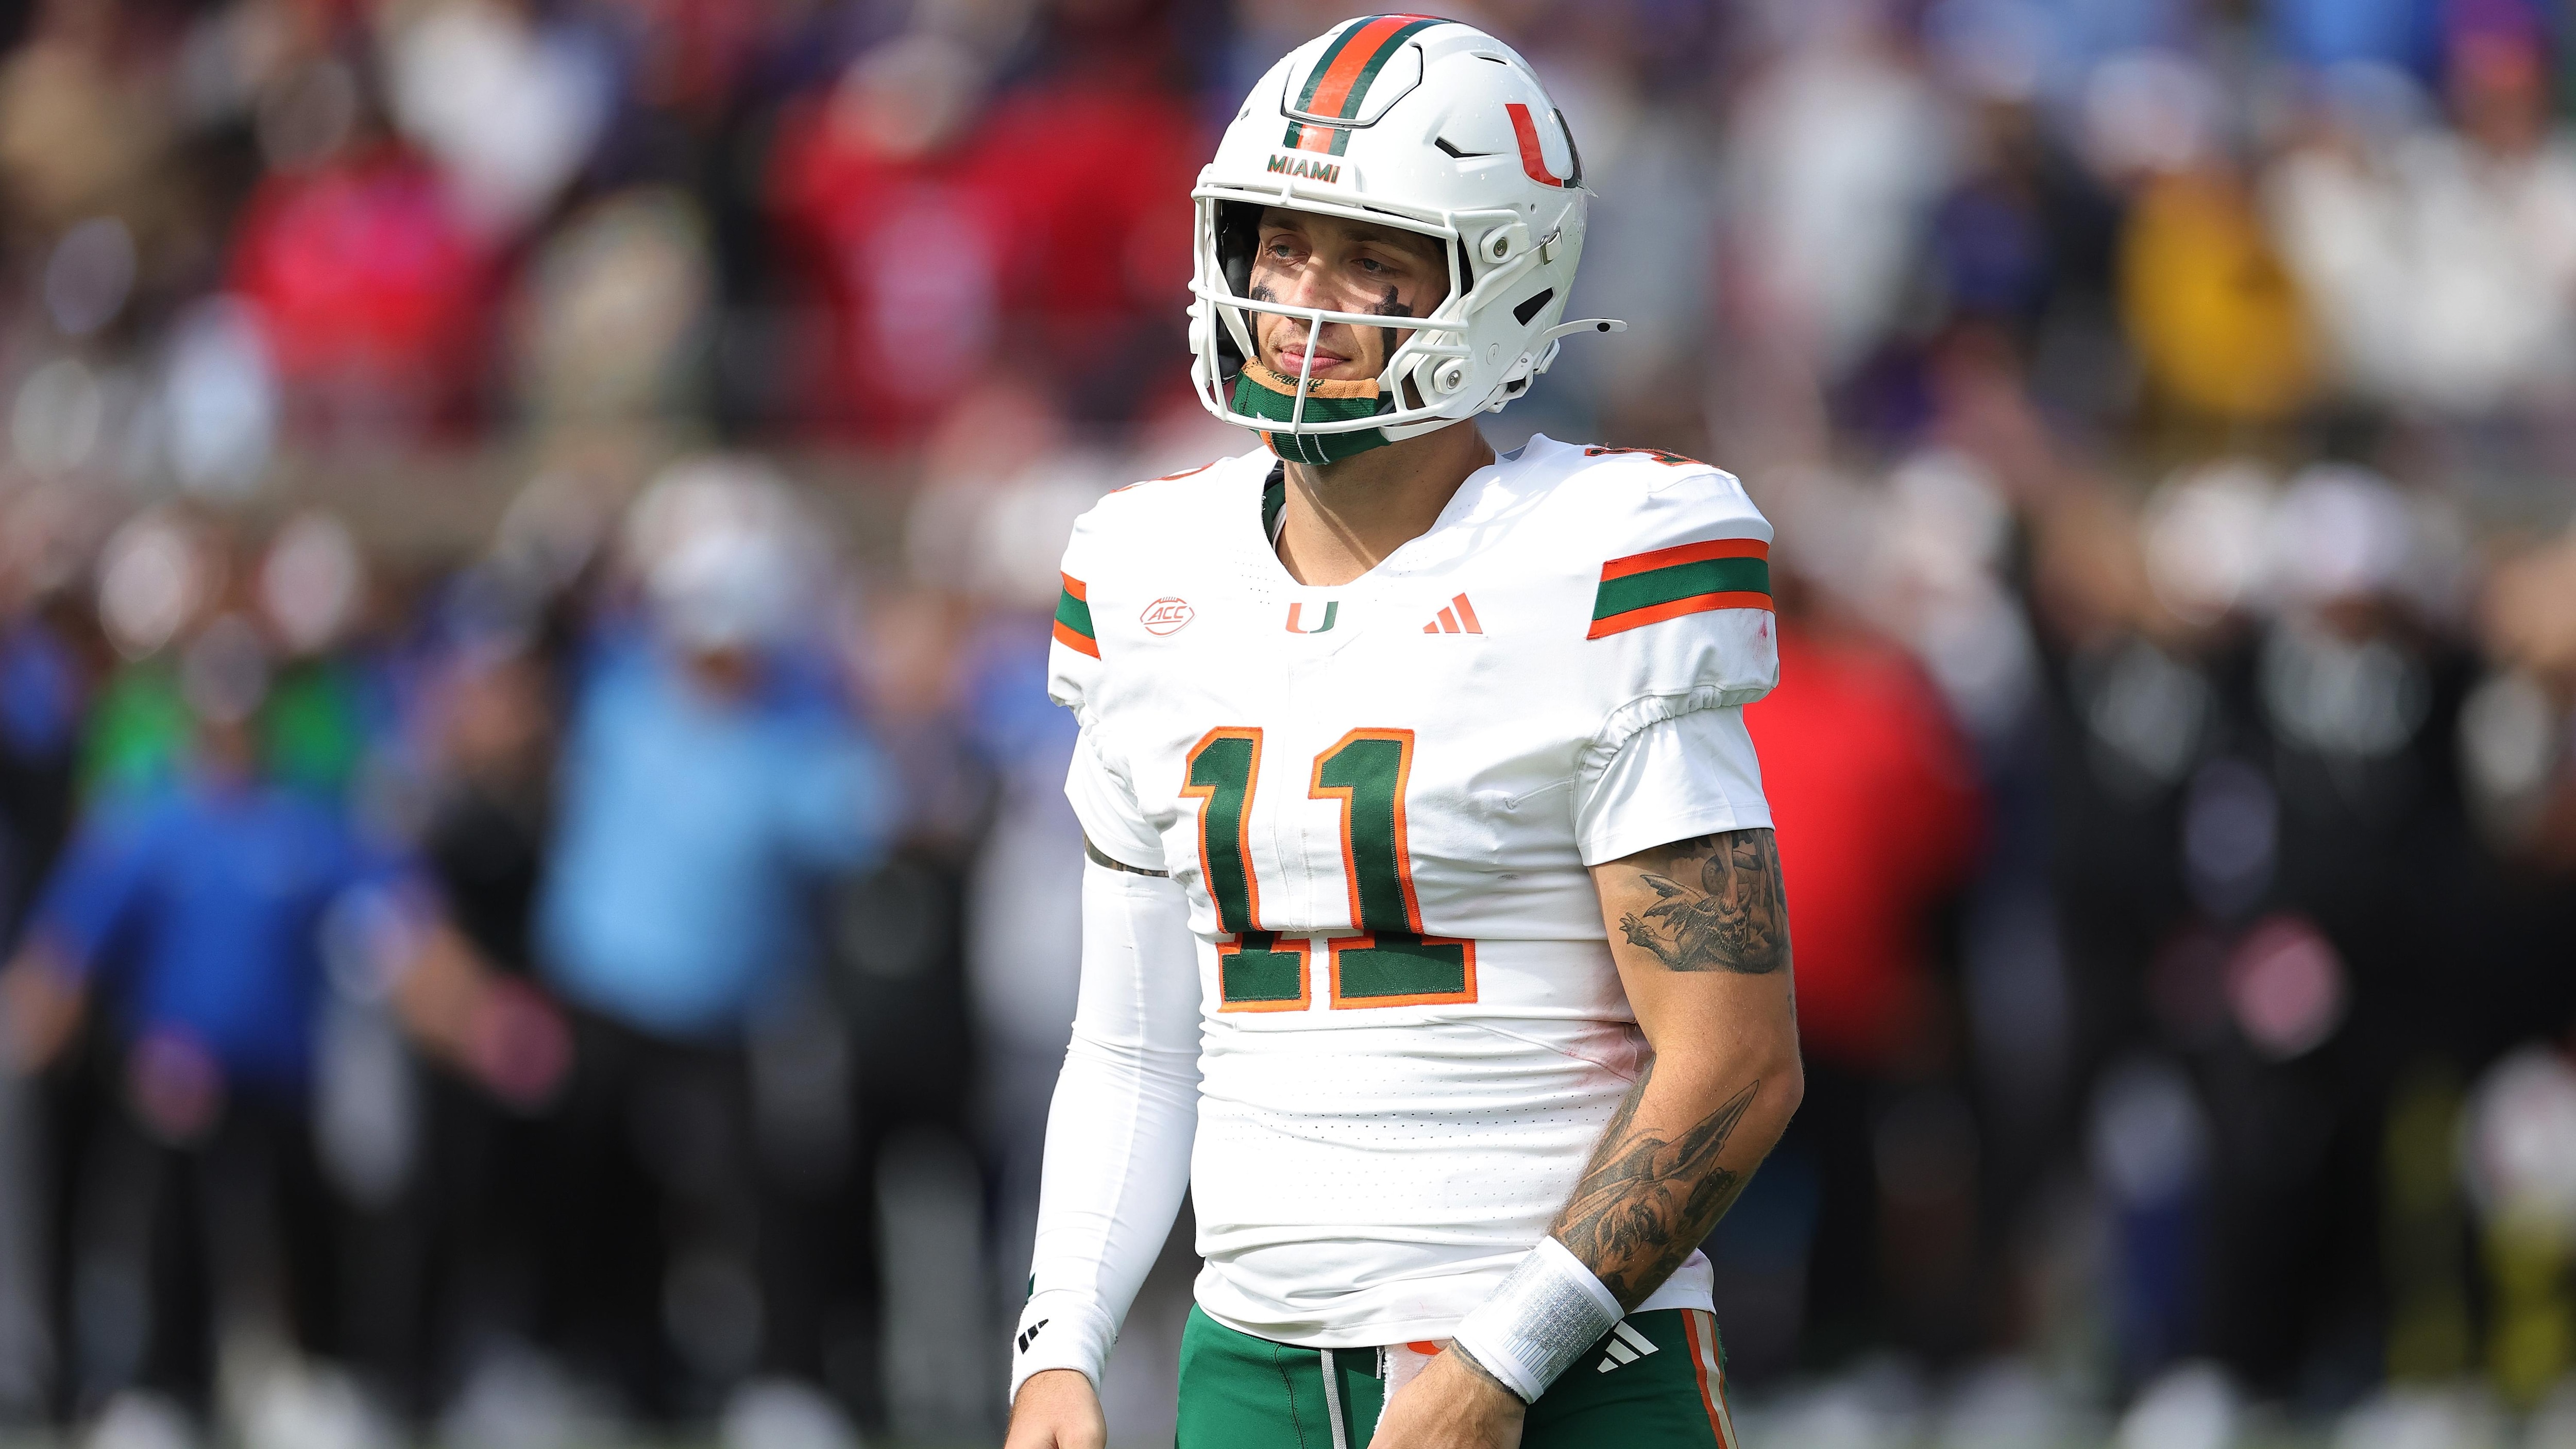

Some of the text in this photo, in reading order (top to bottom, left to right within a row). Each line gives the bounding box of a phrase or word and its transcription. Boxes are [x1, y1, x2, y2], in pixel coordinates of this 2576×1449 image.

[1504, 103, 1583, 190] U
[1267, 154, 1341, 184] MIAMI
[1147, 605, 1188, 621] ACC
[1285, 601, 1339, 634] U
[1178, 726, 1478, 1013] 11
[1561, 1291, 1571, 1302] COCK
[1565, 1295, 1575, 1305] COCK
[1568, 1298, 1578, 1308] LOOP
[1571, 1302, 1581, 1311] ROOK
[1548, 1312, 1558, 1322] BNCH
[1561, 1318, 1571, 1328] TWST
[1564, 1320, 1574, 1331] TWST
[1527, 1331, 1539, 1343] (PICK)
